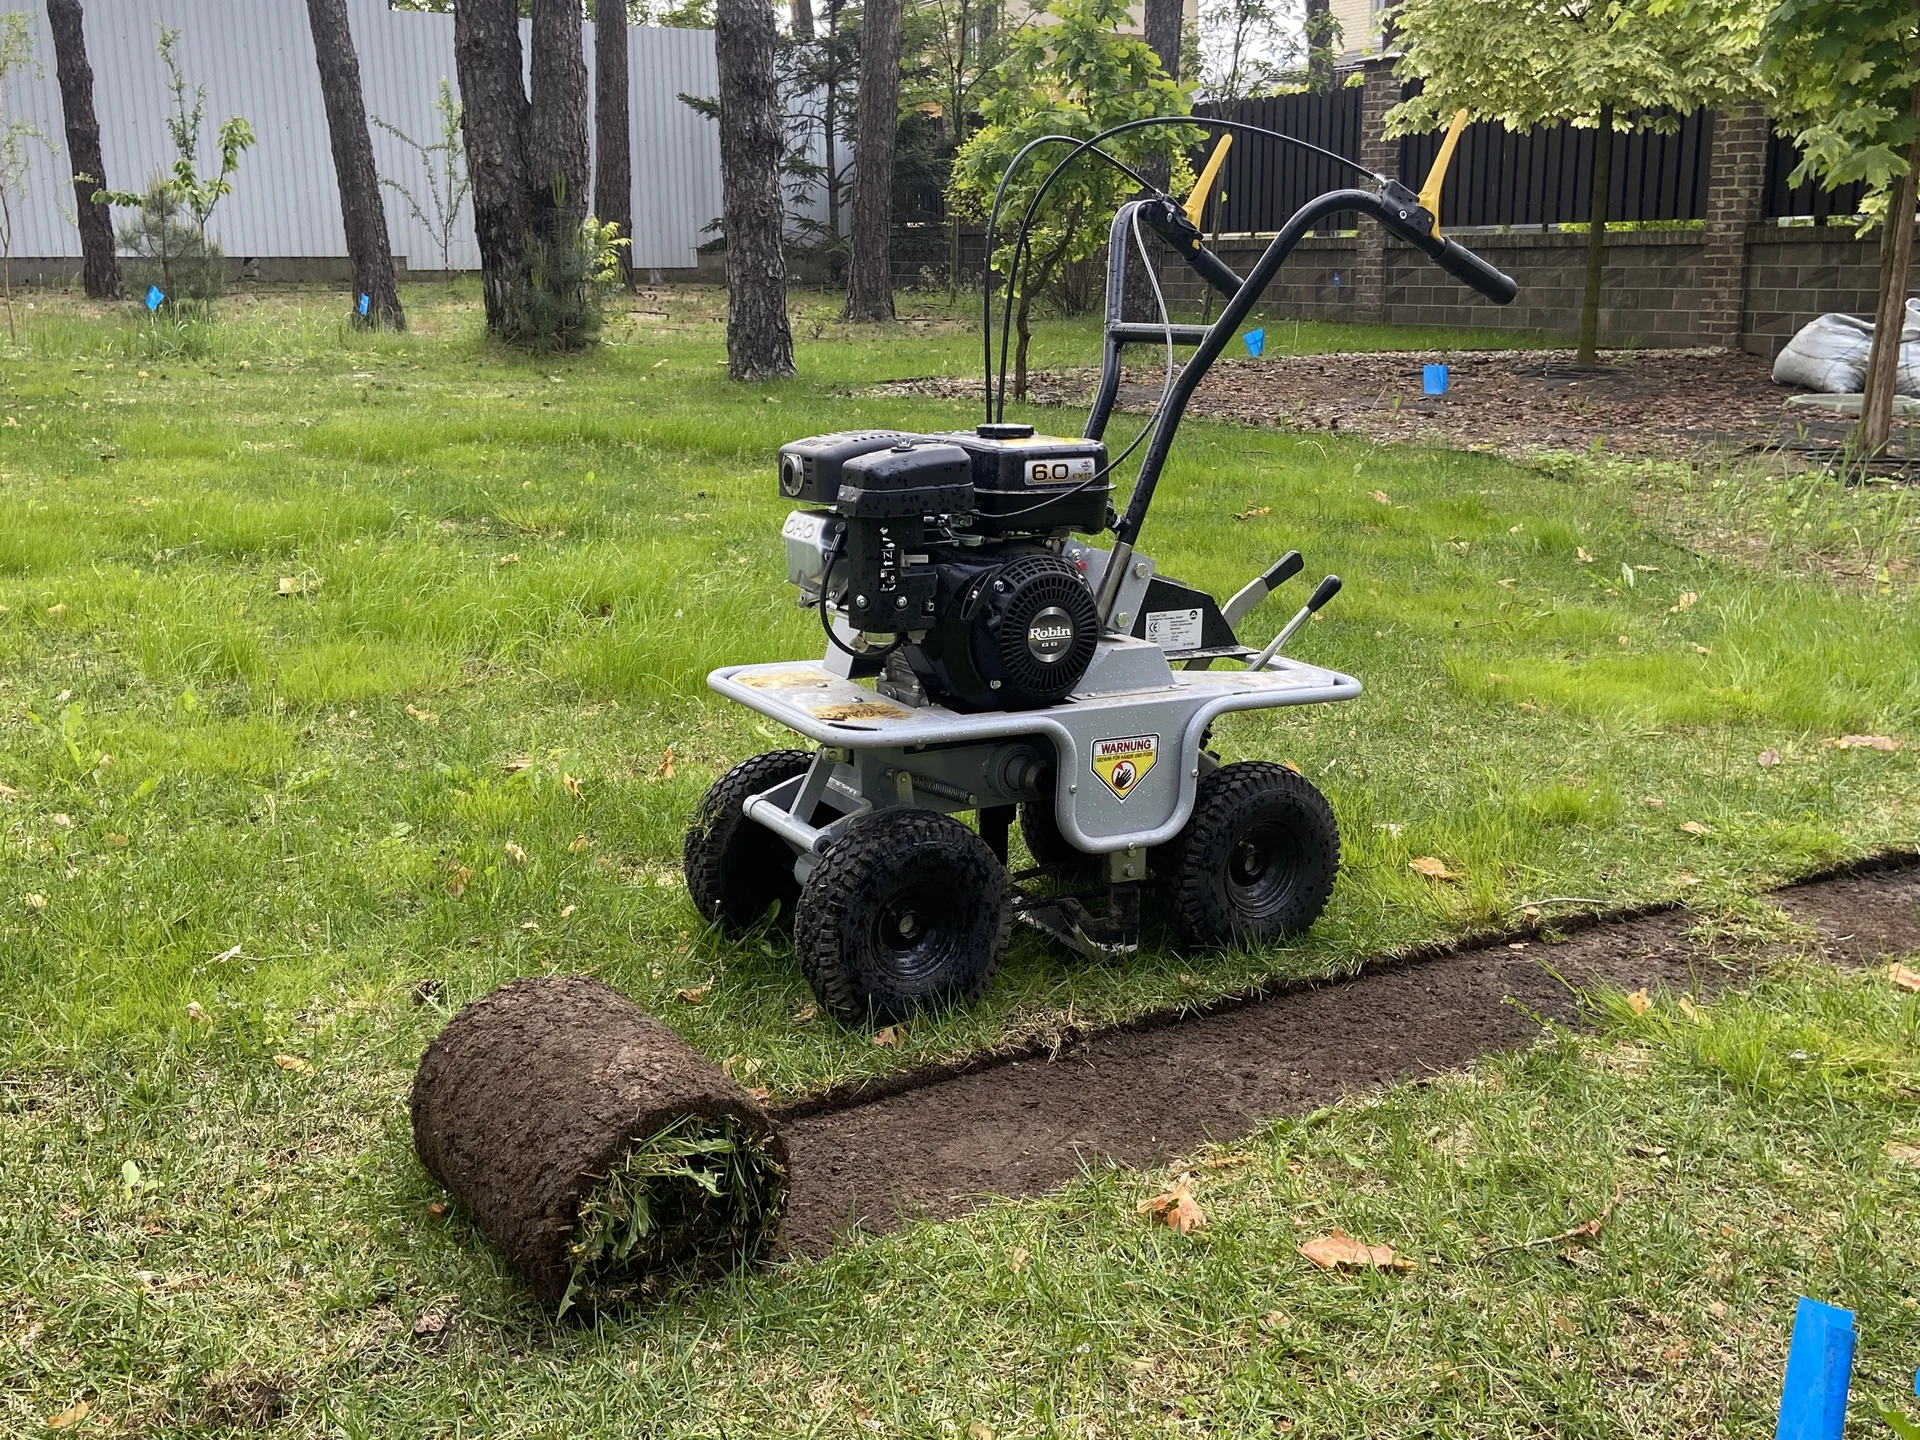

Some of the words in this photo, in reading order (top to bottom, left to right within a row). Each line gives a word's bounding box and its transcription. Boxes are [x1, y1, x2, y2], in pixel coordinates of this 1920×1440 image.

[1032, 464, 1069, 480] 6.0
[1030, 626, 1071, 640] Robin
[1101, 739, 1151, 755] WARNUNG
